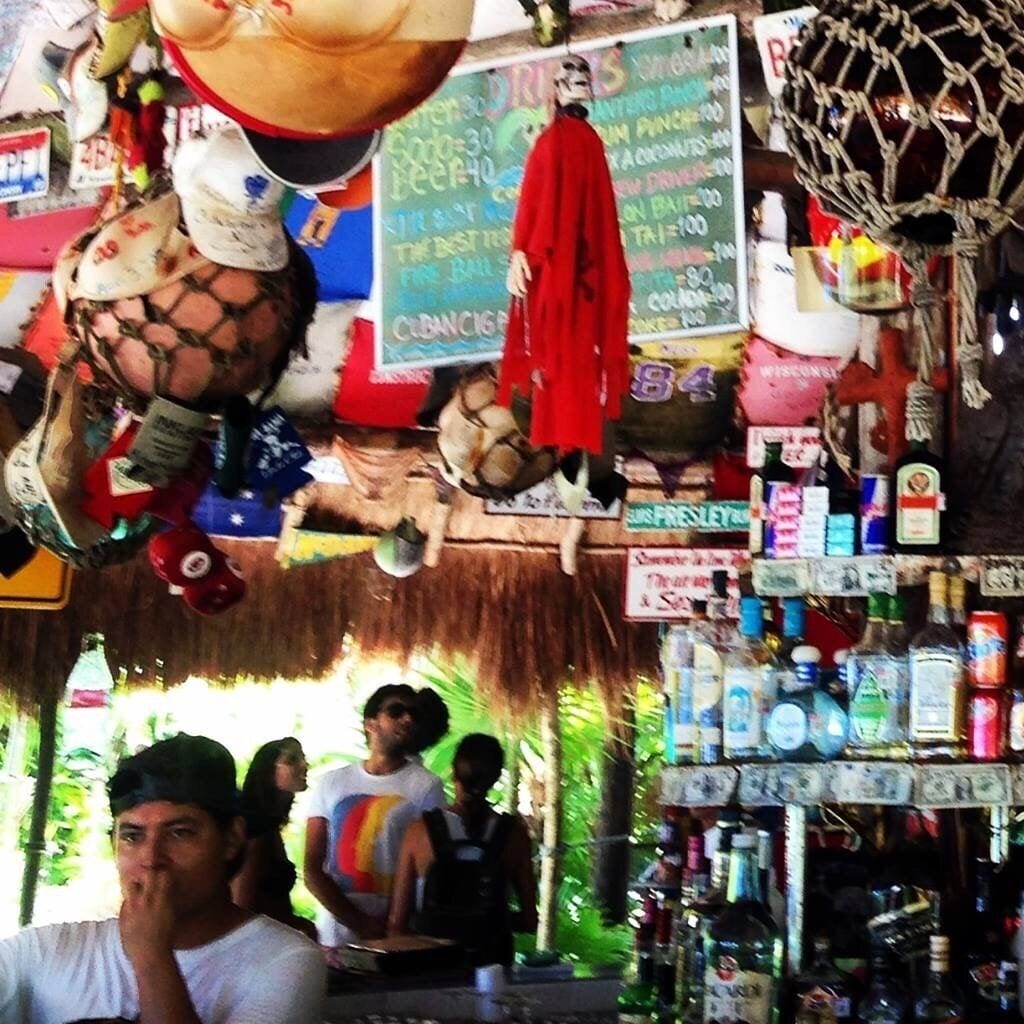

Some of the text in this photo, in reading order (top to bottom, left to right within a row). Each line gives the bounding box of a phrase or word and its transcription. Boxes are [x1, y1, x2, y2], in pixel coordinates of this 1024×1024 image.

[485, 49, 628, 117] DRIS
[630, 362, 718, 403] 84
[653, 502, 730, 529] PRESLEY
